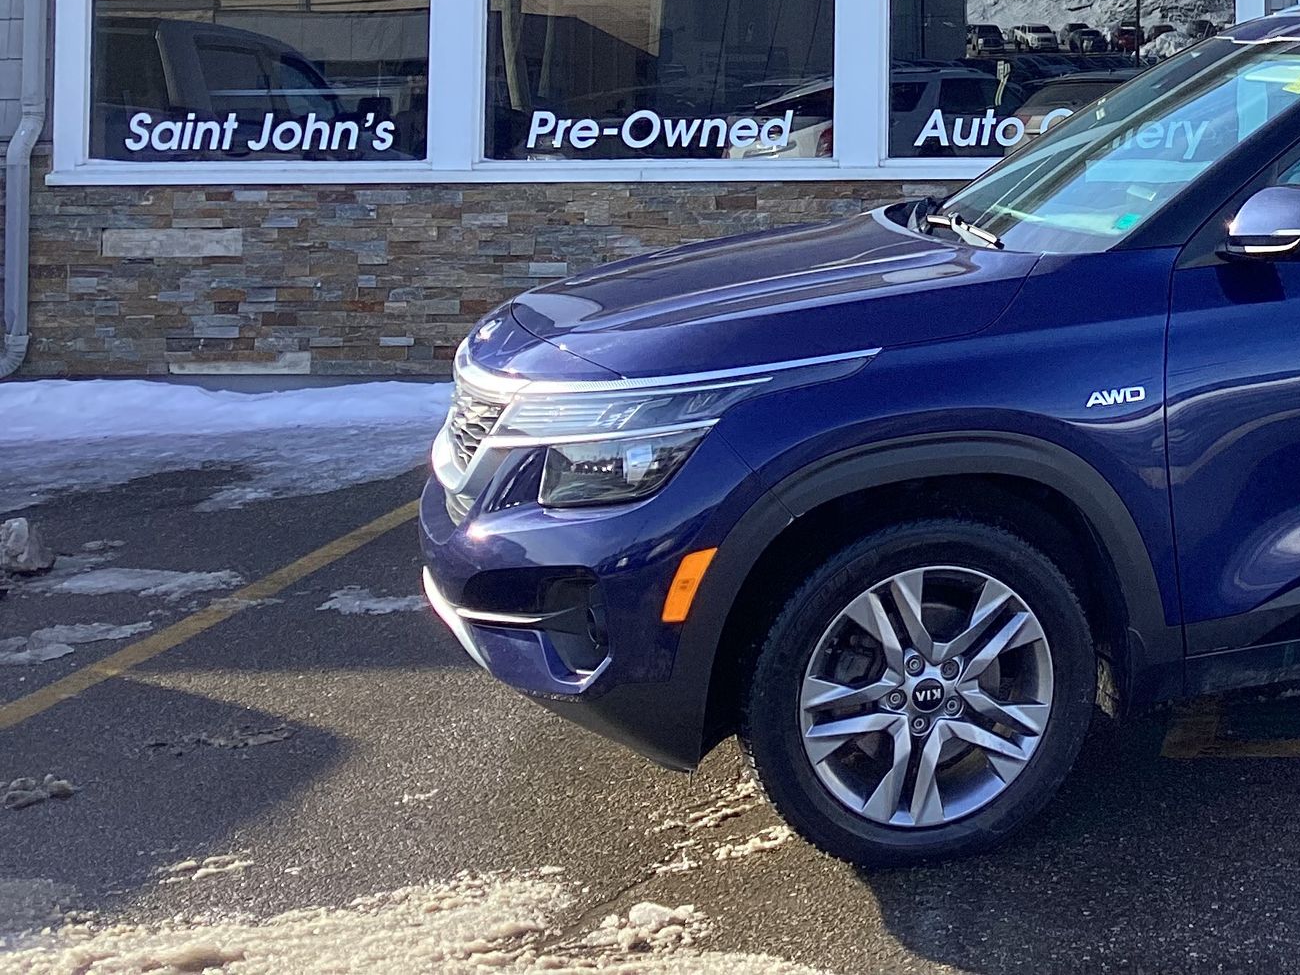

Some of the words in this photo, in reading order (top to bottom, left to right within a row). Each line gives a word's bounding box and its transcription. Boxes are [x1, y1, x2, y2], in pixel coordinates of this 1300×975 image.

[125, 112, 238, 151] Saint
[247, 112, 396, 151] John's
[527, 109, 794, 148] Pre-Owned
[913, 108, 1025, 147] Auto
[1086, 386, 1146, 407] AWD
[915, 688, 941, 702] KIA
